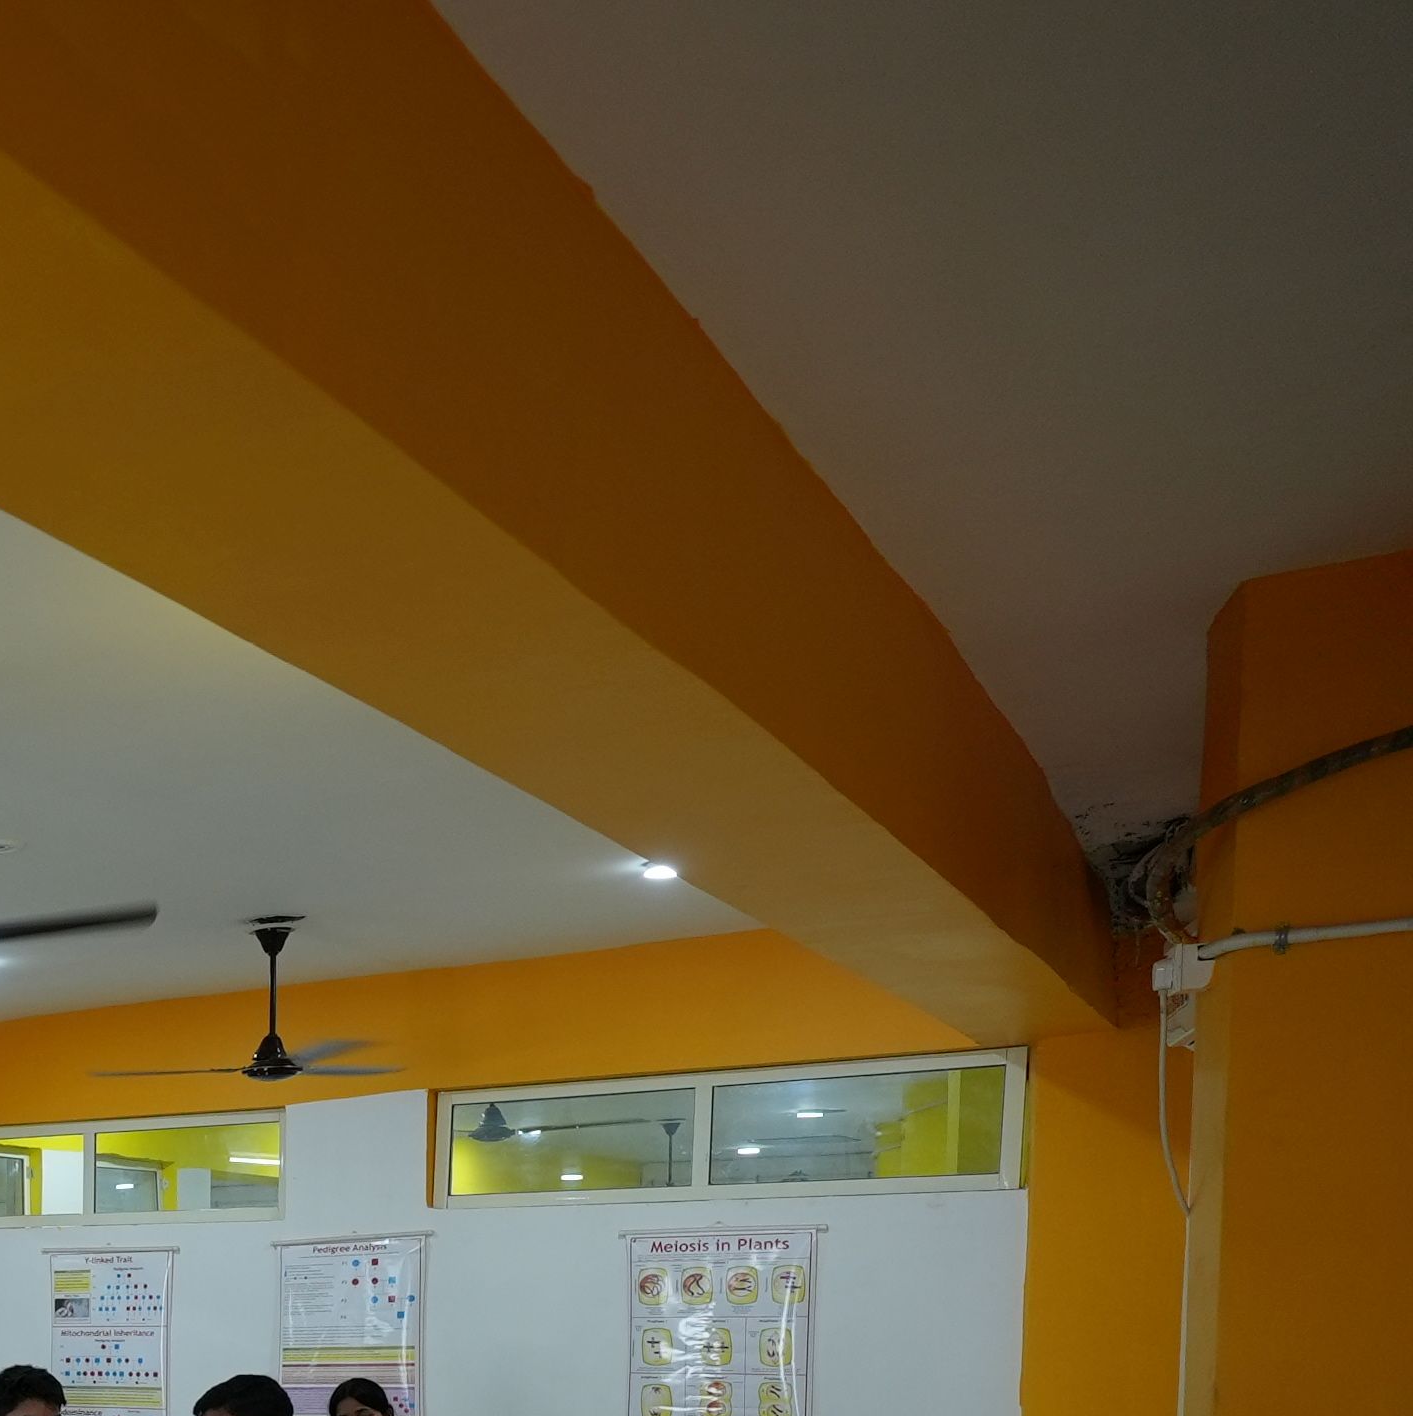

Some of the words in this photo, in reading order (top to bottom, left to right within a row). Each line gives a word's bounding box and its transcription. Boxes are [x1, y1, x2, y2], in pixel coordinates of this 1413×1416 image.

[312, 1245, 351, 1255] Pedigree
[352, 1243, 388, 1253] Analysis
[650, 1240, 710, 1254] Meiosis
[716, 1239, 731, 1252] in
[737, 1238, 790, 1252] Plants
[84, 1256, 114, 1264] Y-Linked
[116, 1255, 133, 1263] Trait
[60, 1329, 111, 1337] Mitochondrial
[113, 1329, 155, 1337] Inheritance
